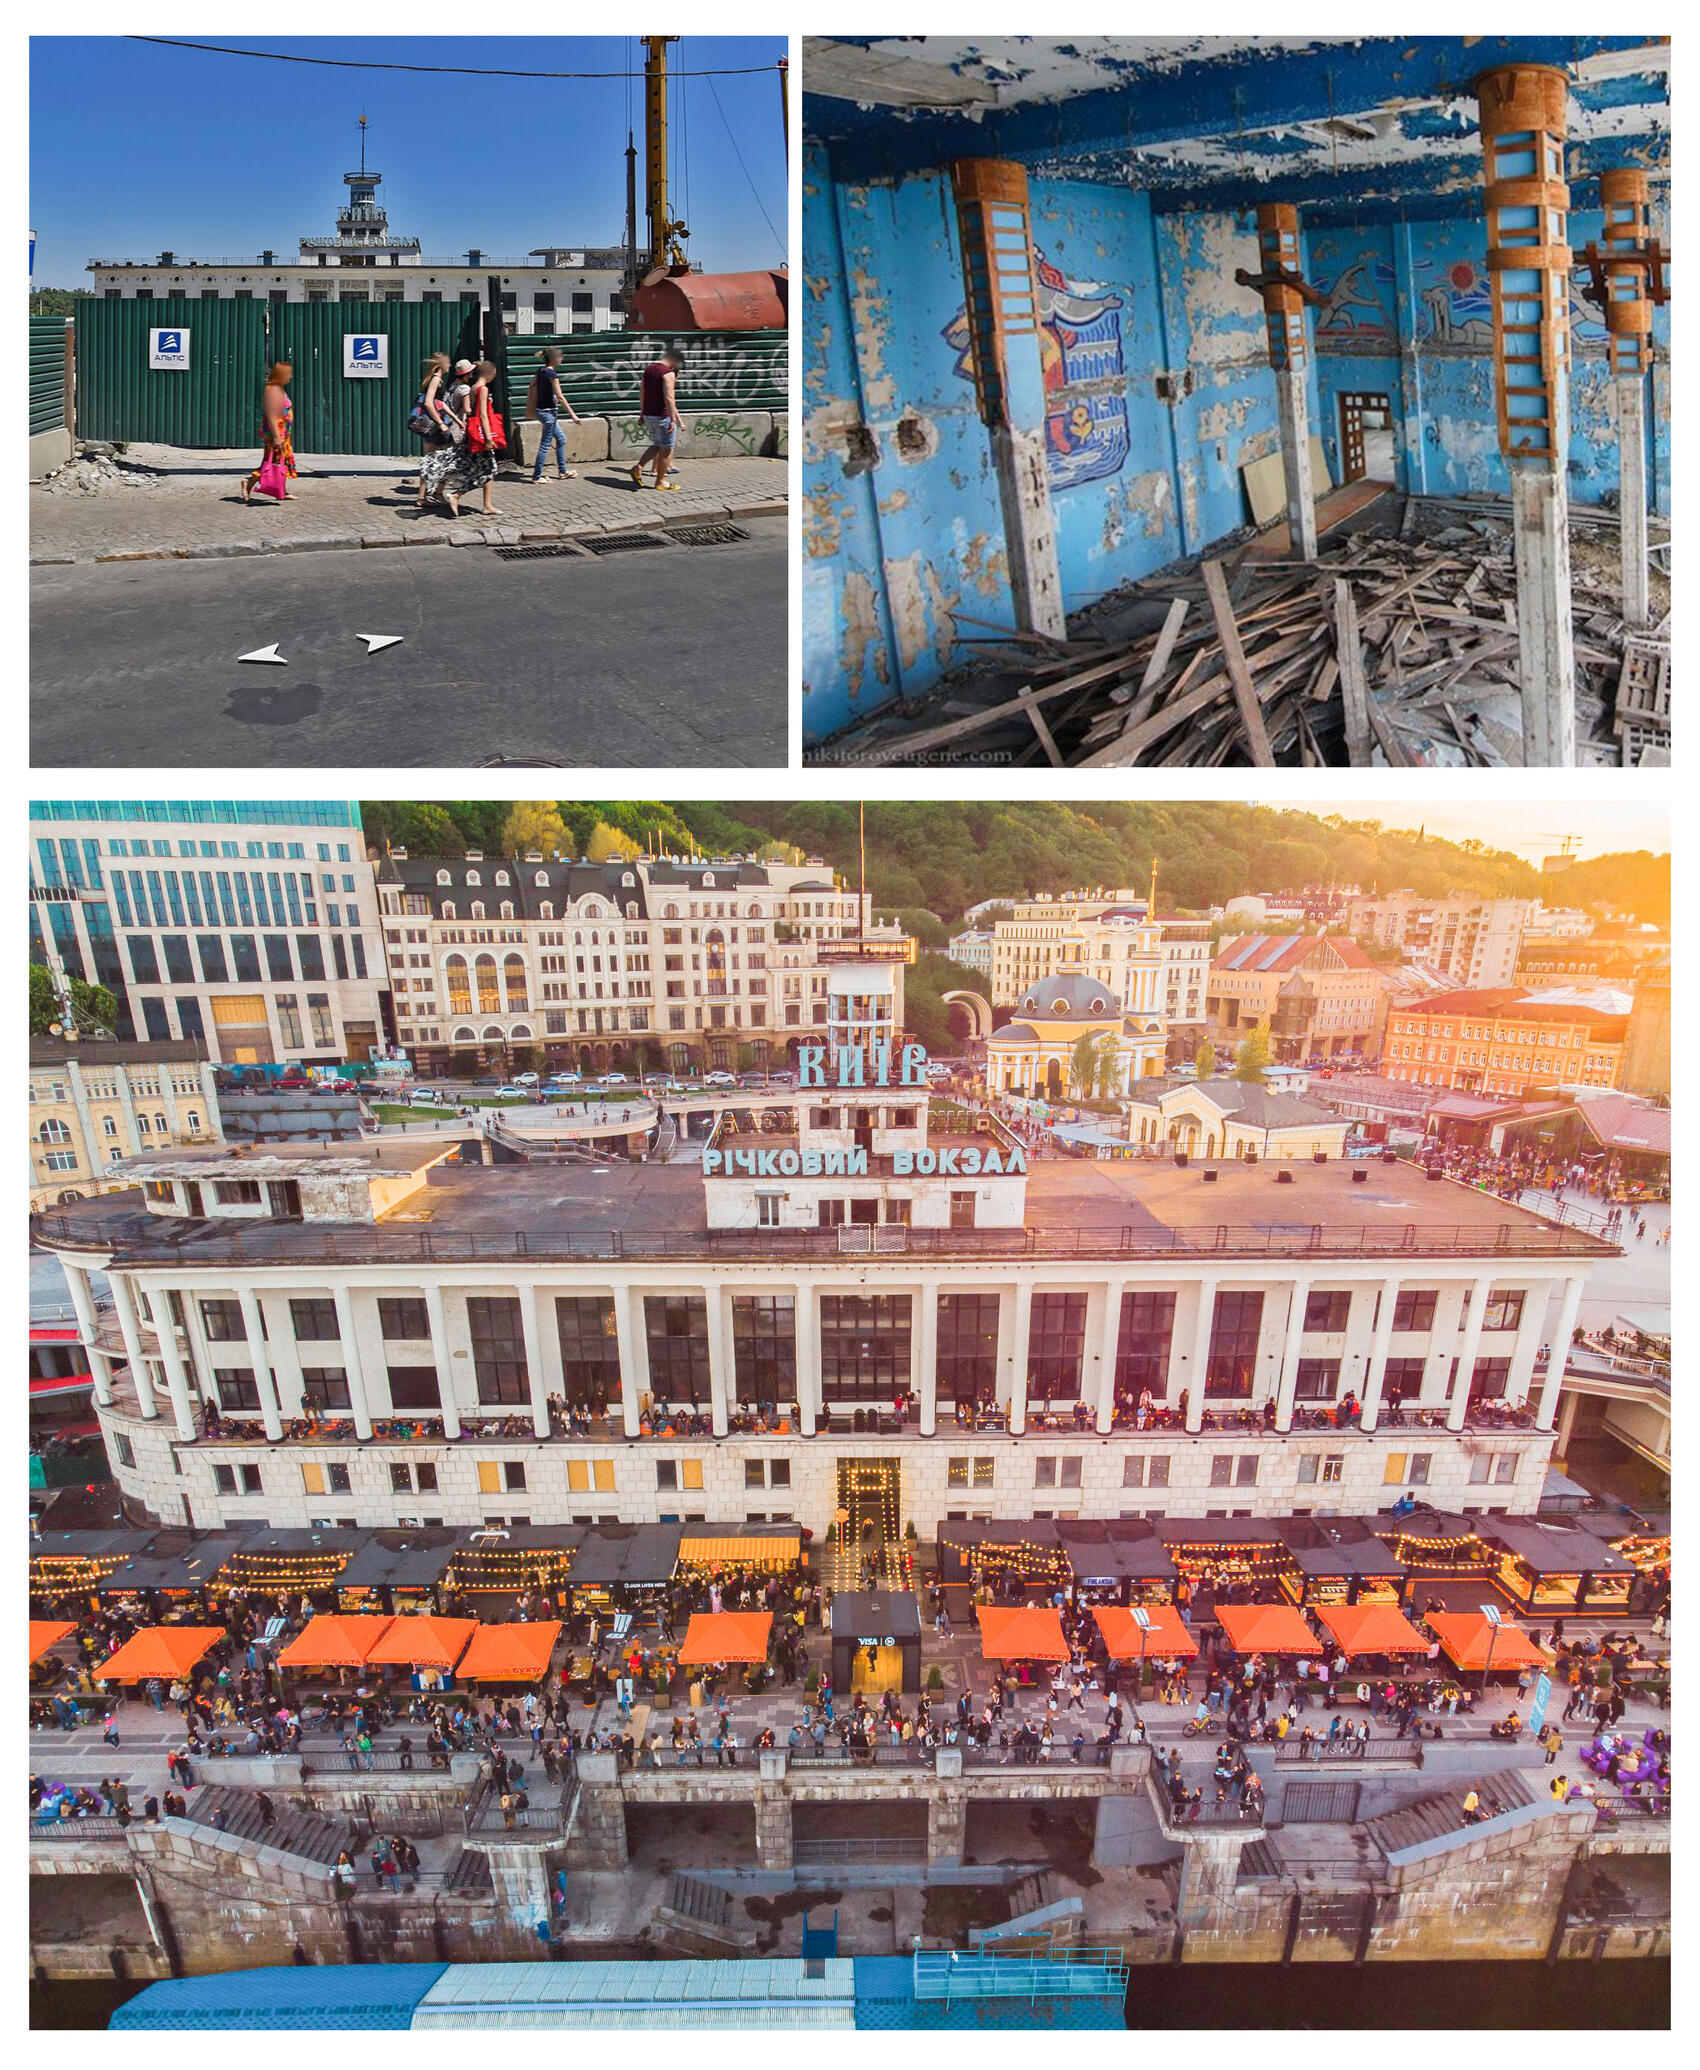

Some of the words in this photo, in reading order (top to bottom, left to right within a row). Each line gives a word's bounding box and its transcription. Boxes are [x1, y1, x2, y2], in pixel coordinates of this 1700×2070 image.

[154, 354, 185, 363] АЛЬТІС
[349, 361, 383, 370] АЛЬТІС
[797, 1037, 928, 1087] КИЇВ
[703, 1145, 868, 1176] РІЧКОВИЙ
[893, 1147, 1027, 1175] ВОКЗАЛ
[858, 1637, 878, 1646] VISA
